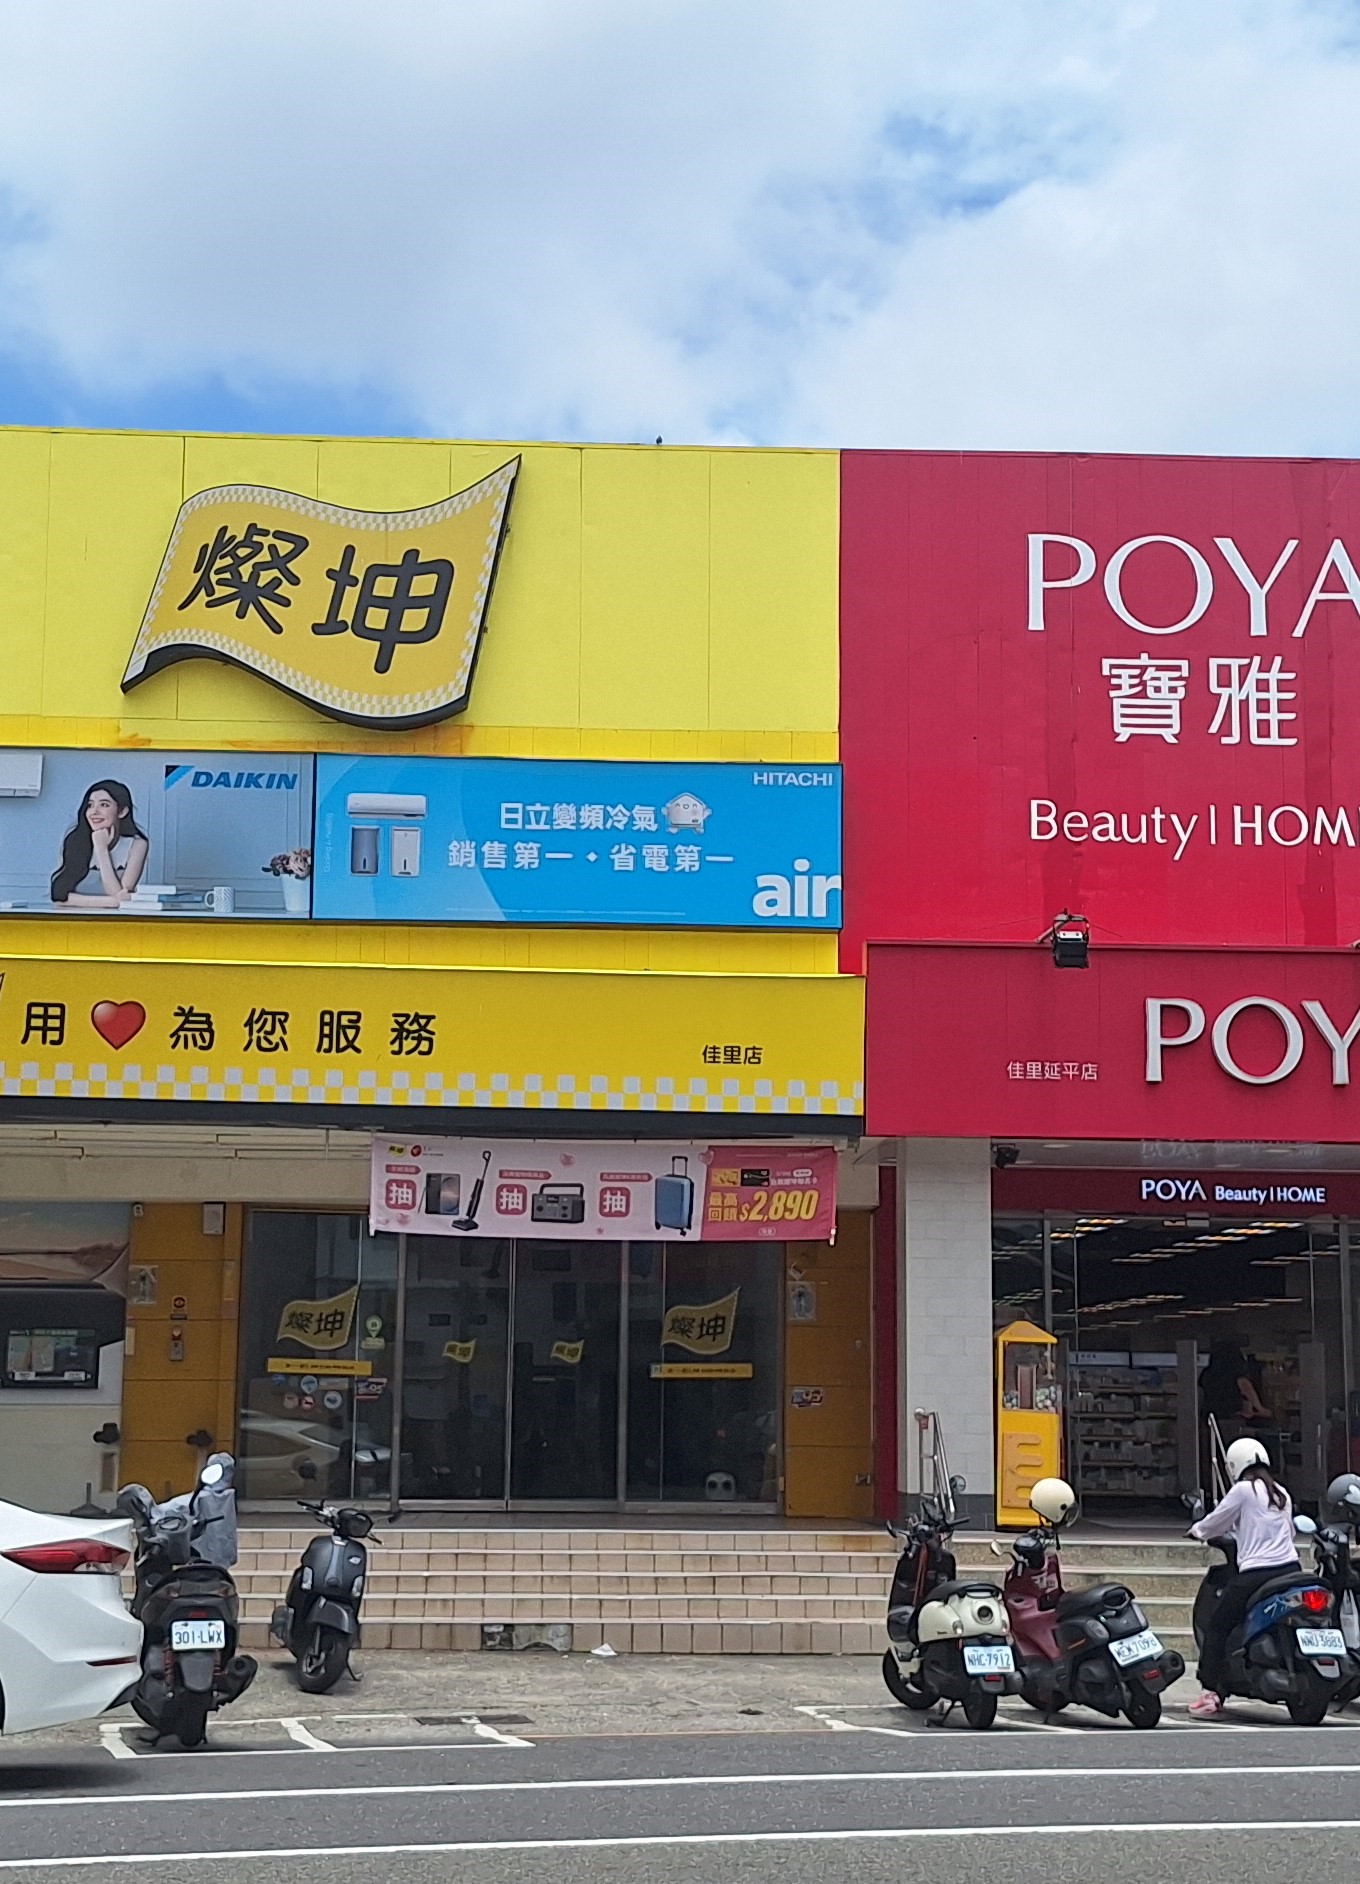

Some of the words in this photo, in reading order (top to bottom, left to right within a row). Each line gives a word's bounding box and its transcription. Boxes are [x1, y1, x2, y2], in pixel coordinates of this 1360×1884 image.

[177, 523, 455, 674] 燦坤
[1101, 652, 1298, 746] 寶雅
[191, 770, 298, 791] DAIKIN
[752, 771, 834, 787] HITACHI
[499, 802, 659, 832] 日立變頻冷氣
[1028, 798, 1199, 862] Beauty
[751, 858, 841, 918] air
[21, 1001, 66, 1047] 用
[169, 1004, 437, 1058] 為您服務
[700, 1043, 764, 1067] 佳里店
[1005, 1060, 1099, 1082] 佳里延平店
[390, 1182, 413, 1206] 抽
[499, 1187, 523, 1211] 抽
[603, 1189, 627, 1214] 抽
[1141, 1178, 1208, 1201] POYA
[1214, 1185, 1267, 1206] Beauty
[1276, 1186, 1326, 1203] HOME
[739, 1190, 819, 1223] $2,890
